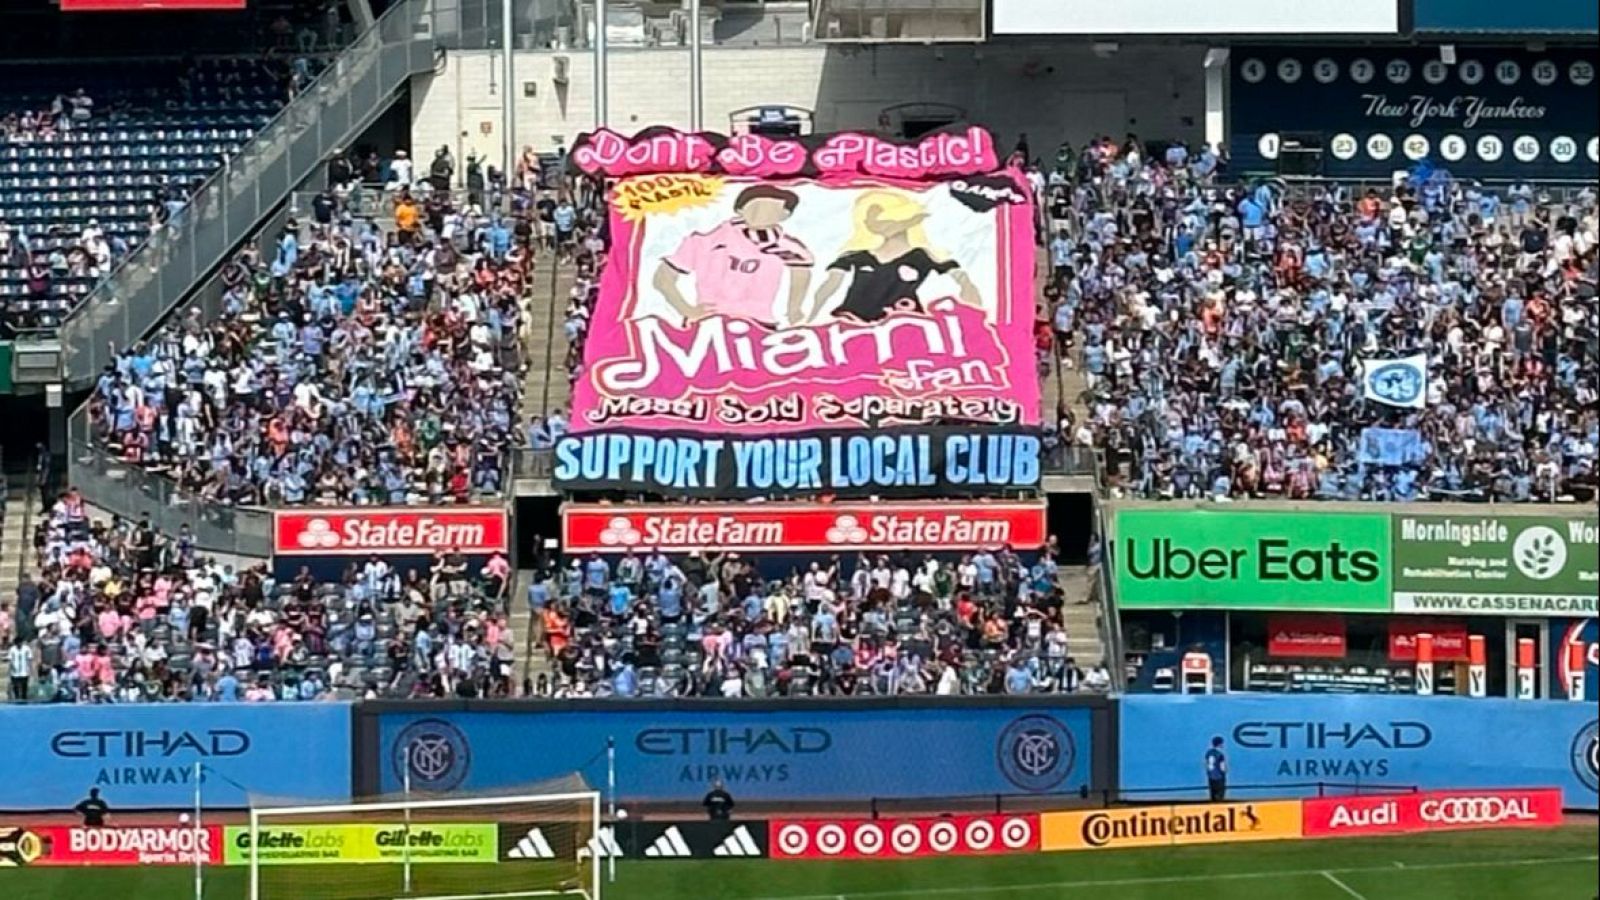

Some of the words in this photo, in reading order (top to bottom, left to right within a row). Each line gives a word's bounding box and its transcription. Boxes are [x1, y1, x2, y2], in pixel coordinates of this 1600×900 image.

[1390, 64, 1407, 77] 37
[1538, 65, 1552, 79] 15
[1361, 94, 1409, 116] New
[1410, 95, 1463, 128] York
[1463, 95, 1546, 128] Yankees
[576, 134, 701, 169] Don't
[718, 134, 795, 166] Be
[816, 127, 984, 169] Plastic!
[1482, 141, 1497, 154] 51
[1555, 142, 1571, 155] 20
[729, 255, 761, 273] 10
[603, 299, 966, 390] Miami
[719, 395, 800, 422] Sold
[554, 435, 723, 488] SUPPORT
[731, 438, 822, 490] YOUR
[830, 435, 936, 487] LOCAL
[945, 435, 1041, 487] CLUB
[1401, 518, 1509, 547] Morningside
[1126, 538, 1248, 580] Uber
[1258, 538, 1380, 582] Eats
[1418, 667, 1429, 689] N
[1471, 670, 1482, 692] Y
[1519, 674, 1530, 695] C
[1571, 676, 1582, 698] F
[51, 729, 250, 757] ETIHAD
[635, 728, 833, 755] ETIHAD
[1232, 722, 1432, 749] ETIHAD
[96, 765, 207, 785] AIRWAYS
[679, 763, 789, 782] AIRWAYS
[1277, 759, 1389, 777] AIRWAYS
[1082, 807, 1236, 847] Continental
[1329, 802, 1398, 827] Audi
[69, 828, 210, 852] BODYARMOR
